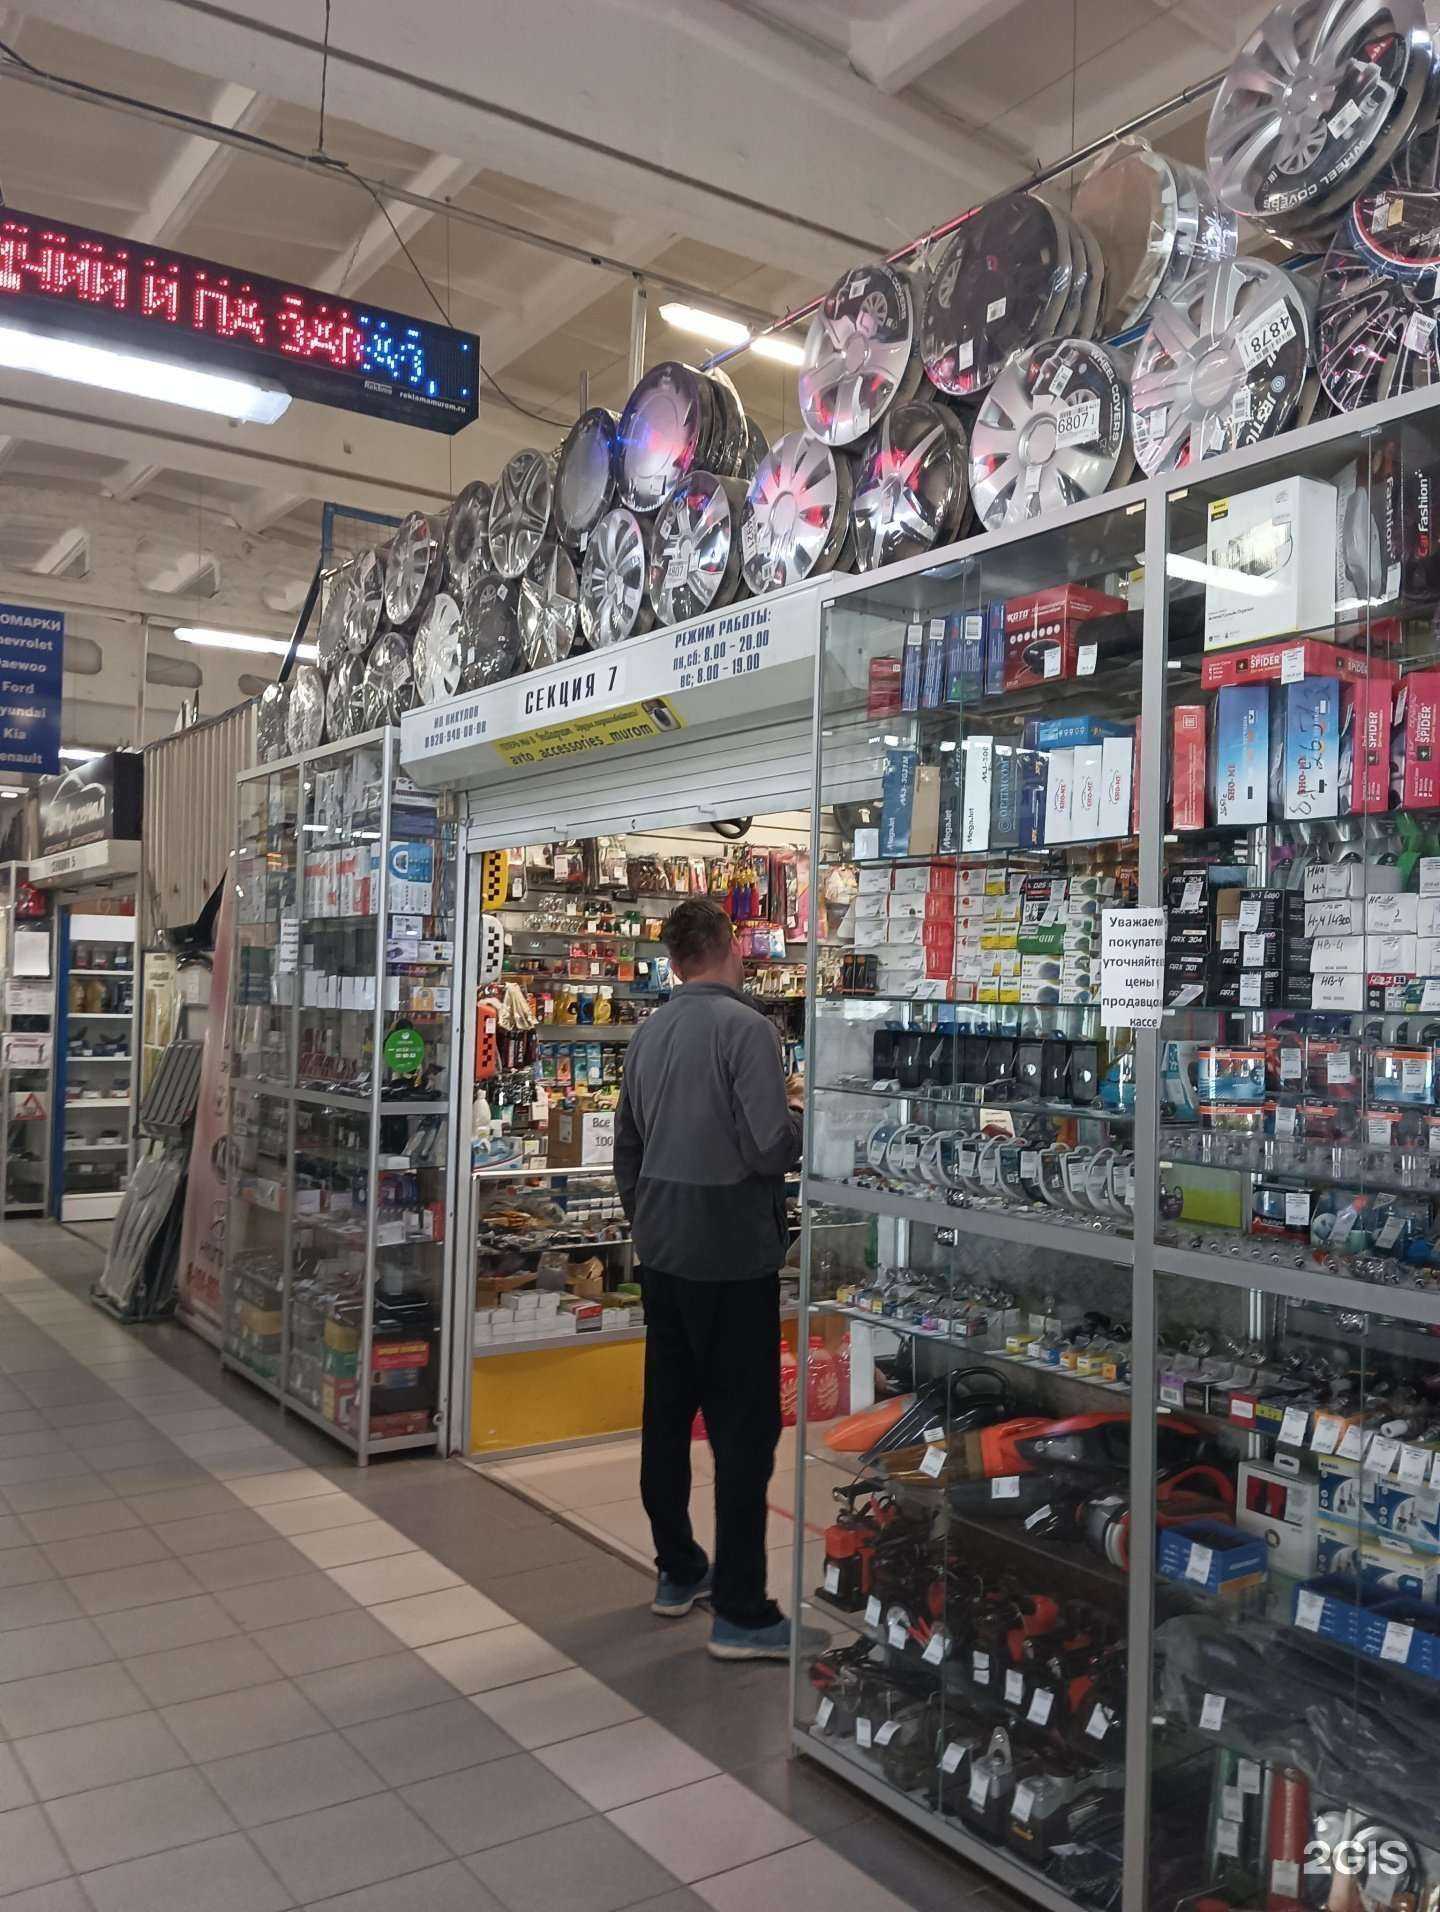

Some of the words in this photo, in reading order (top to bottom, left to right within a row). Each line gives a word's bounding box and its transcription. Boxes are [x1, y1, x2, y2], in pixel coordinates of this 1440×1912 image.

[1250, 314, 1291, 353] 4878
[400, 391, 467, 414] reklamamurom.ru
[1090, 350, 1116, 384] WHEEL
[1111, 384, 1121, 441] COVERS
[1058, 412, 1089, 434] 6807
[1417, 477, 1429, 533] Fashion
[675, 624, 715, 648] РЕЖИМ
[719, 608, 771, 636] РАБОТЫ:
[704, 642, 726, 663] 8.00
[739, 629, 769, 653] 20.00
[1250, 655, 1281, 669] SPIDER
[697, 663, 719, 684] 8.00
[732, 652, 760, 675] 19.00
[2, 681, 35, 694] Ford
[525, 671, 596, 715] СЕКЦИЯ
[608, 666, 618, 691] 7
[3, 727, 27, 740] Kia
[1367, 711, 1378, 749] SPIDER
[1420, 706, 1432, 744] SPIDER
[509, 723, 654, 766] avto_accessories_murom
[1000, 758, 1010, 818] OPTIMCOM
[942, 809, 953, 850] MegaJet
[967, 807, 976, 845] MegaJet
[1125, 978, 1155, 989] цены
[1169, 963, 1183, 971] ARX
[1185, 963, 1197, 971] 301
[1129, 1018, 1158, 1028] кассе
[592, 1117, 611, 1128] Все
[595, 1135, 614, 1147] 100
